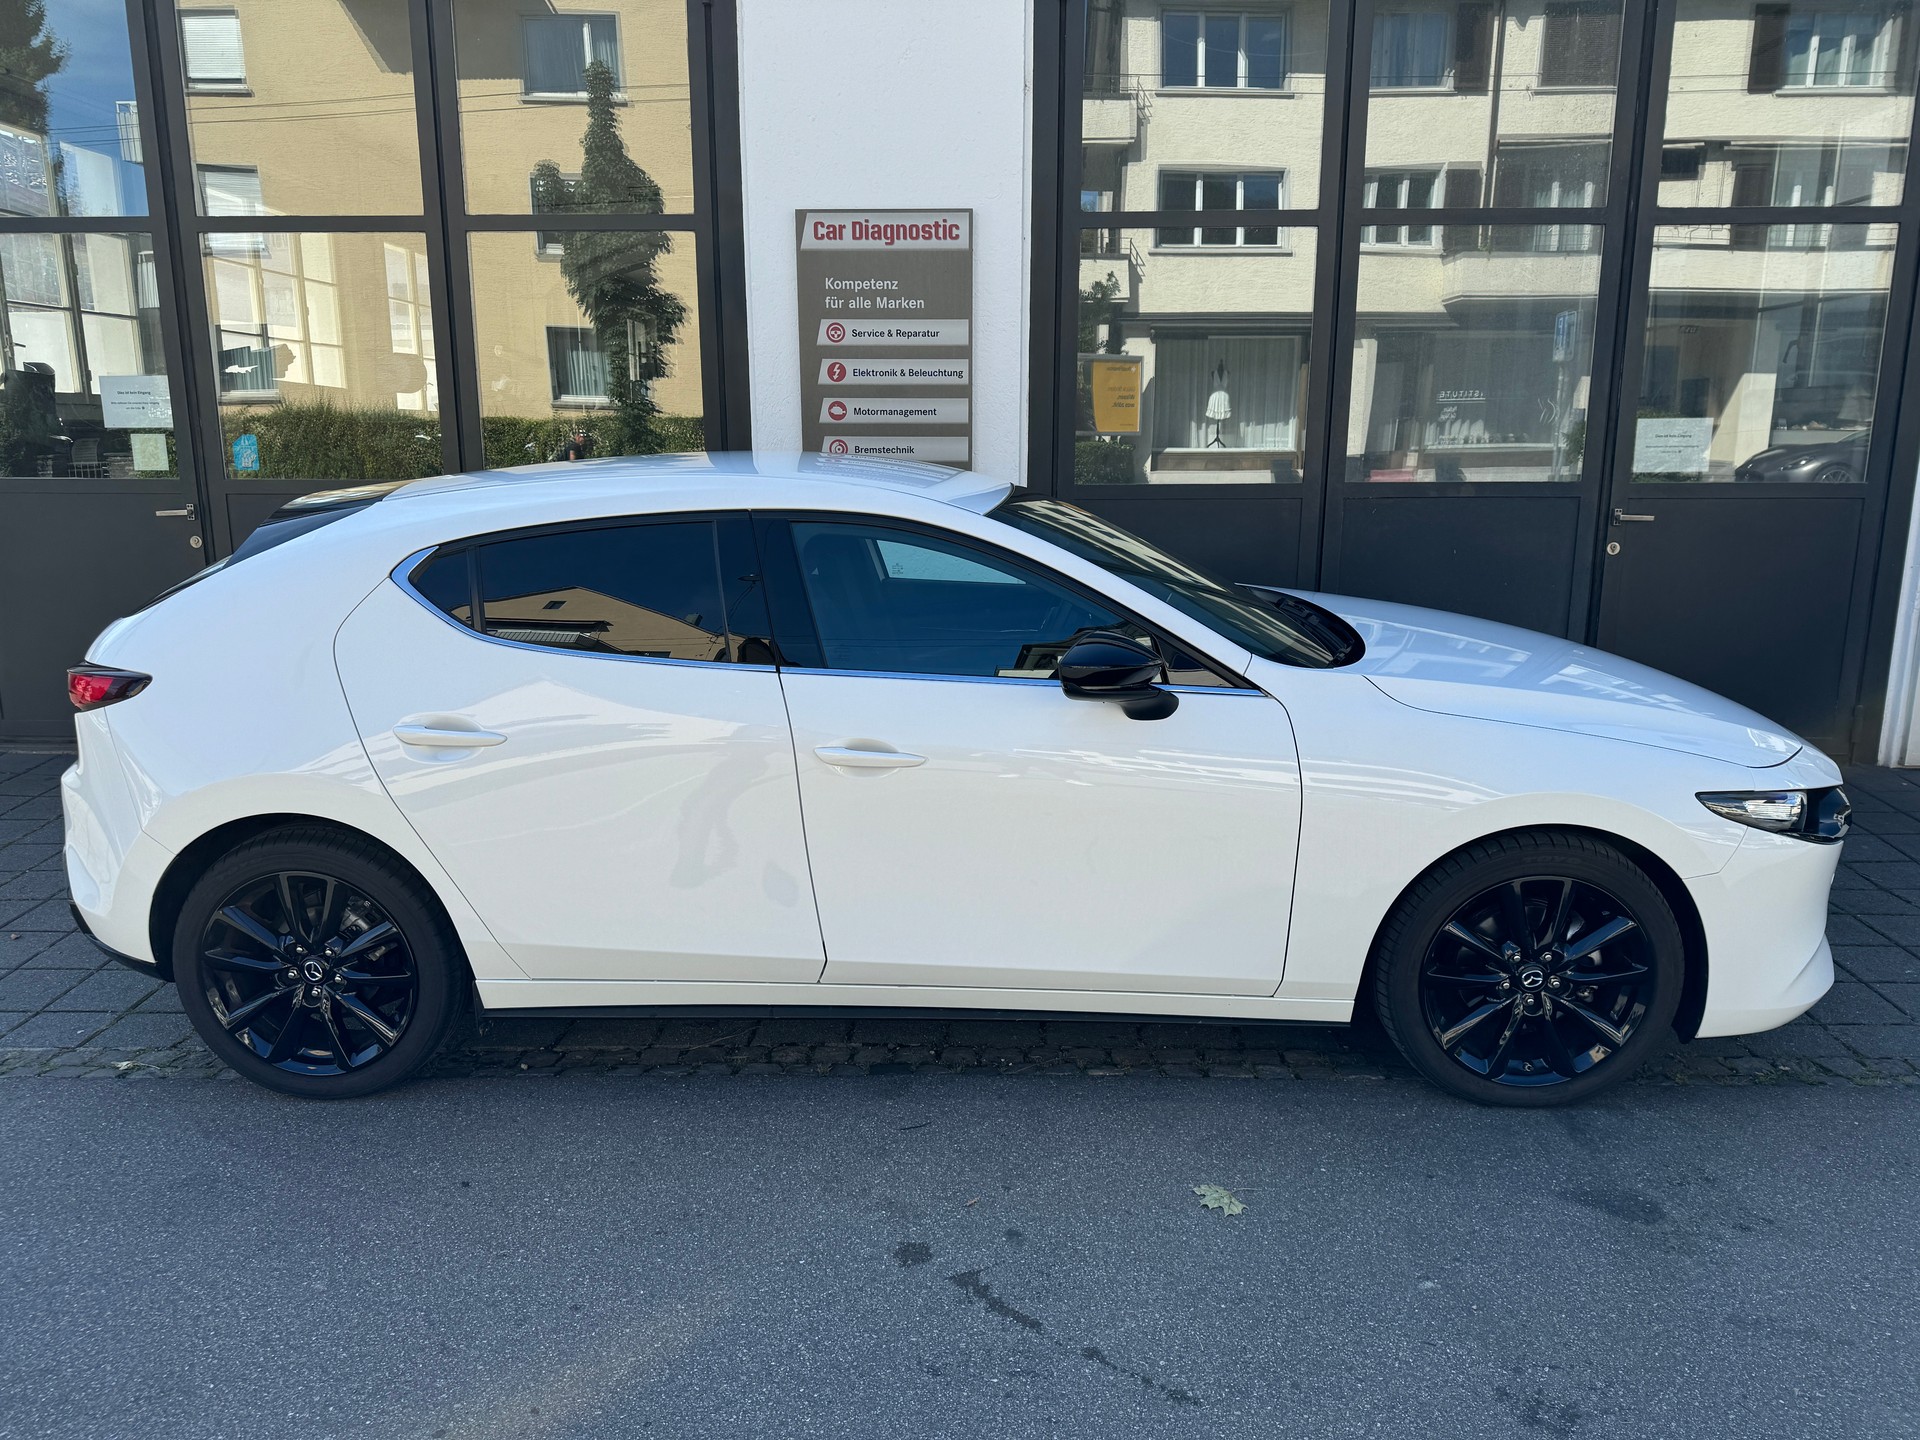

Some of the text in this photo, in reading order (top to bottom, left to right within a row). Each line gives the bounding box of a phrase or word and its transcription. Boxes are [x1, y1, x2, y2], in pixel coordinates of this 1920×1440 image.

[813, 219, 960, 246] Car Diagnostic
[825, 277, 899, 293] Kompetenz
[825, 297, 925, 309] für alle Marken
[851, 328, 940, 339] Service & Reparatur
[852, 368, 964, 379] Elektronik & Beleuchtung
[853, 407, 937, 418] Motormanagement
[854, 445, 915, 455] Bremstechnik
